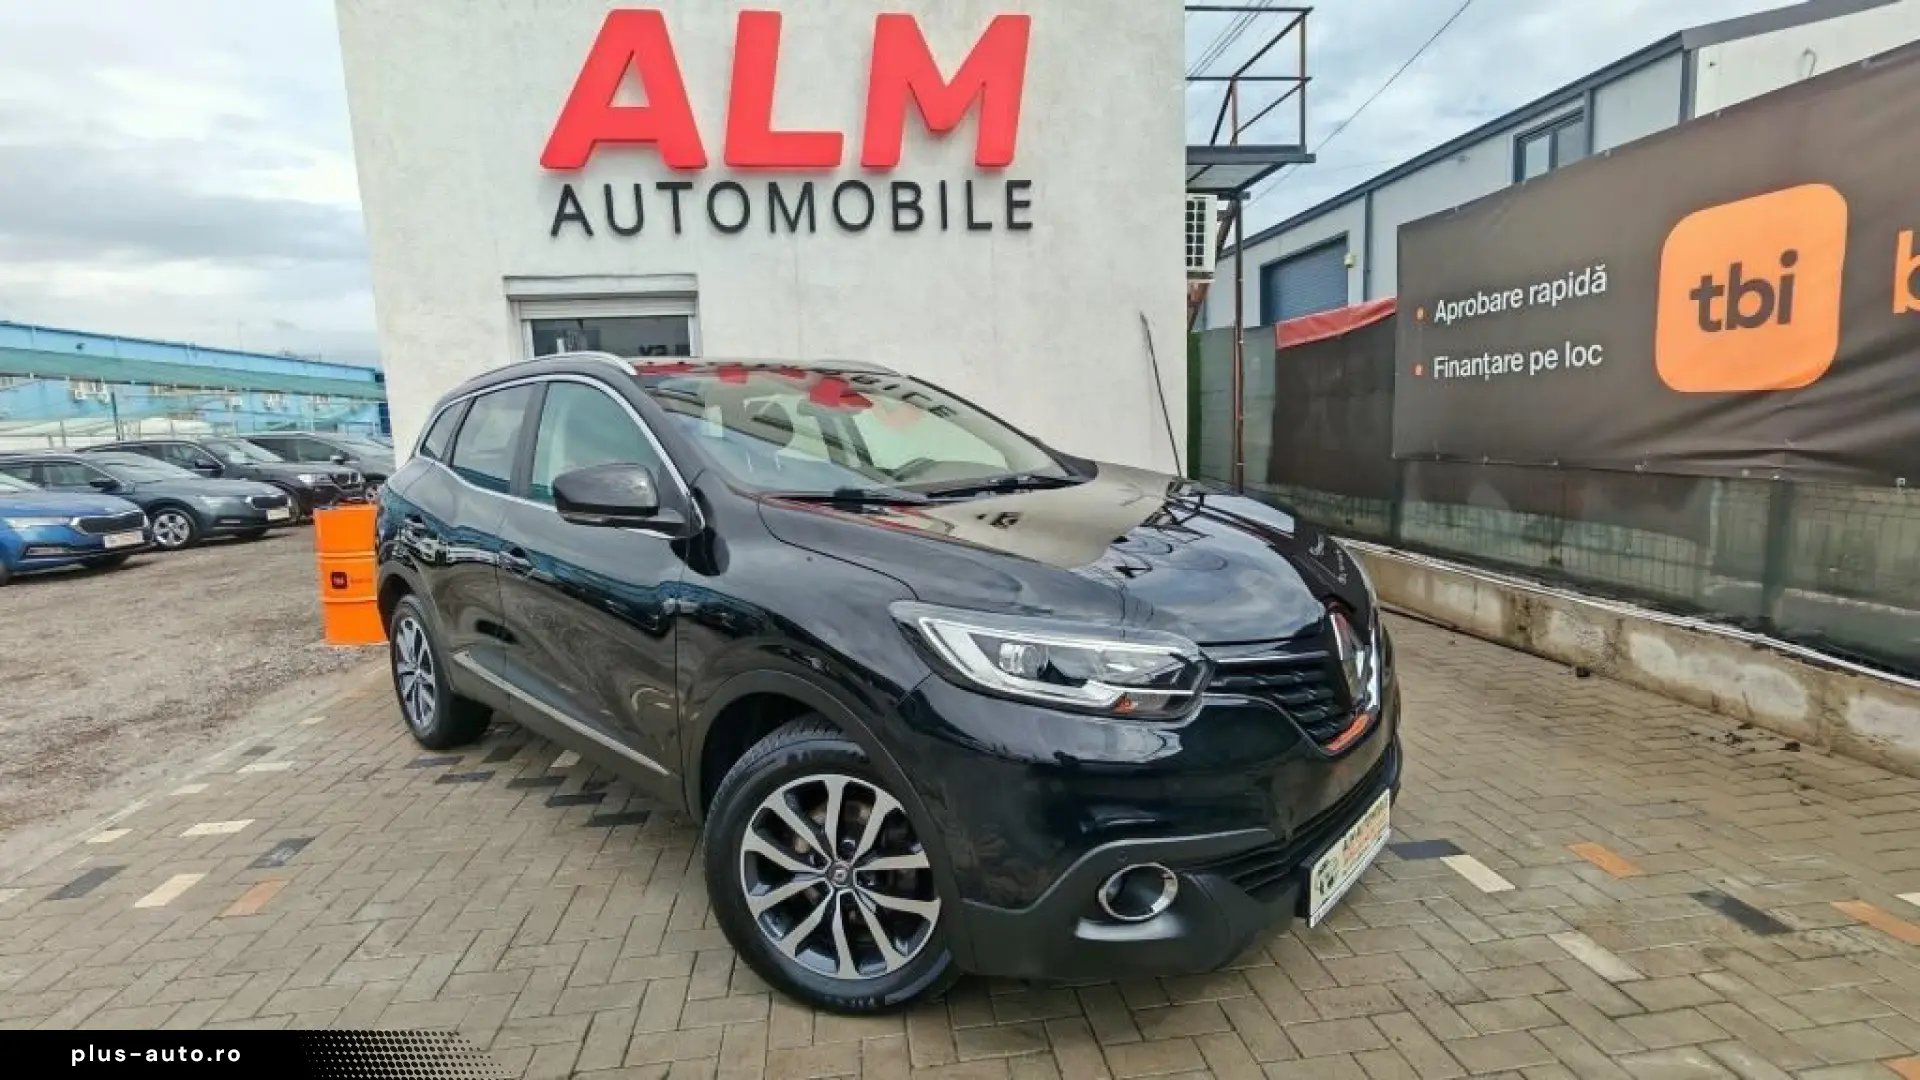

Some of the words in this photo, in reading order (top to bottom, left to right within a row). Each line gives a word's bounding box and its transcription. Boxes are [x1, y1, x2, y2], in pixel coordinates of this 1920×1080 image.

[539, 8, 1032, 169] ALM
[551, 180, 1032, 236] AUTOMOBILE
[1433, 288, 1524, 325] Aprobare
[1529, 263, 1608, 307] rapidă
[1689, 249, 1799, 332] tbi
[1433, 352, 1524, 381] Finanțare
[1529, 348, 1559, 376] pe
[1565, 341, 1604, 369] loc
